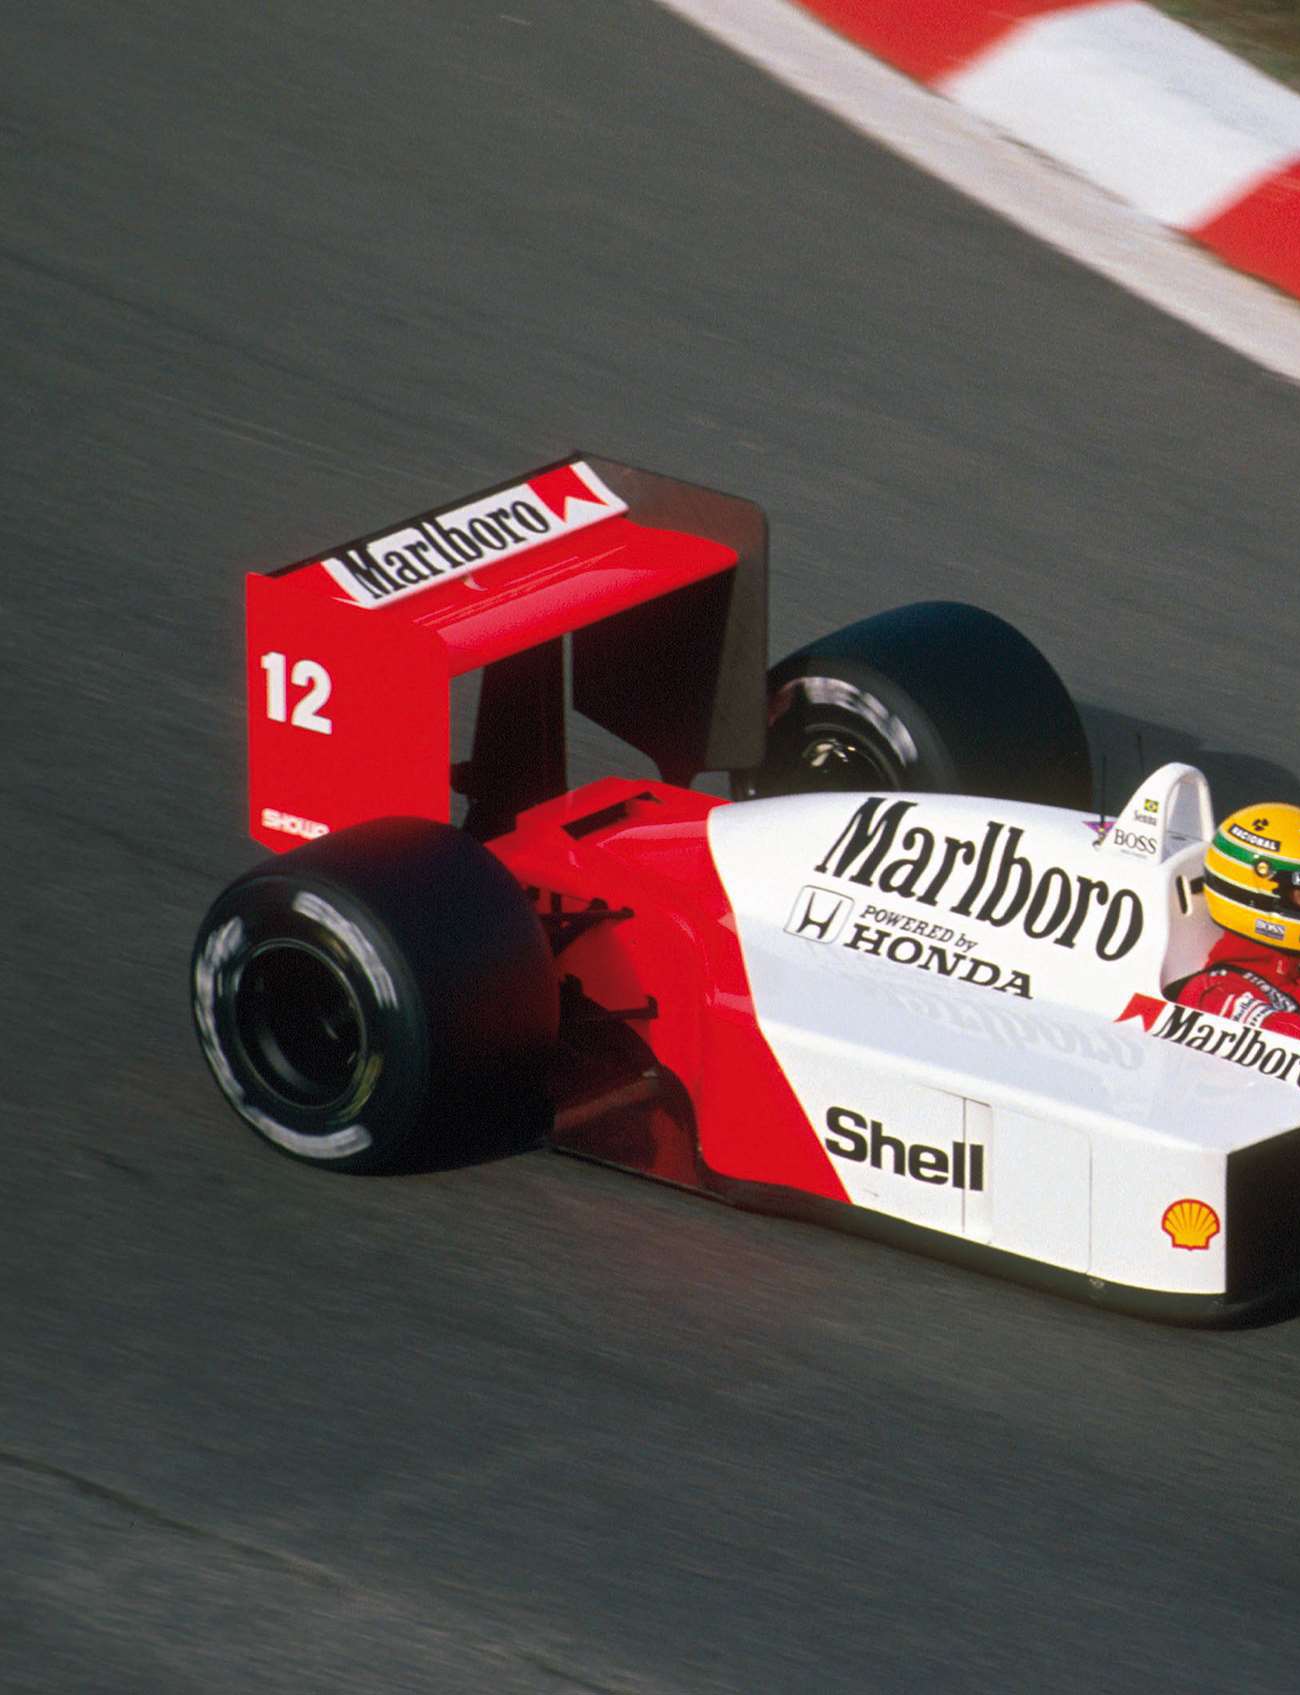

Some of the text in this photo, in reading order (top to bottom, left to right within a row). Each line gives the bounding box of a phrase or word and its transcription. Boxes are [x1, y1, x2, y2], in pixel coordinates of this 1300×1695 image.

[347, 501, 549, 599] Marlboro
[261, 652, 332, 735] 12
[814, 797, 1144, 961] Marlboro
[1114, 828, 1157, 855] BOSS
[844, 924, 1033, 999] HONDA
[860, 905, 978, 953] POWERED by
[825, 1106, 984, 1191] Shell
